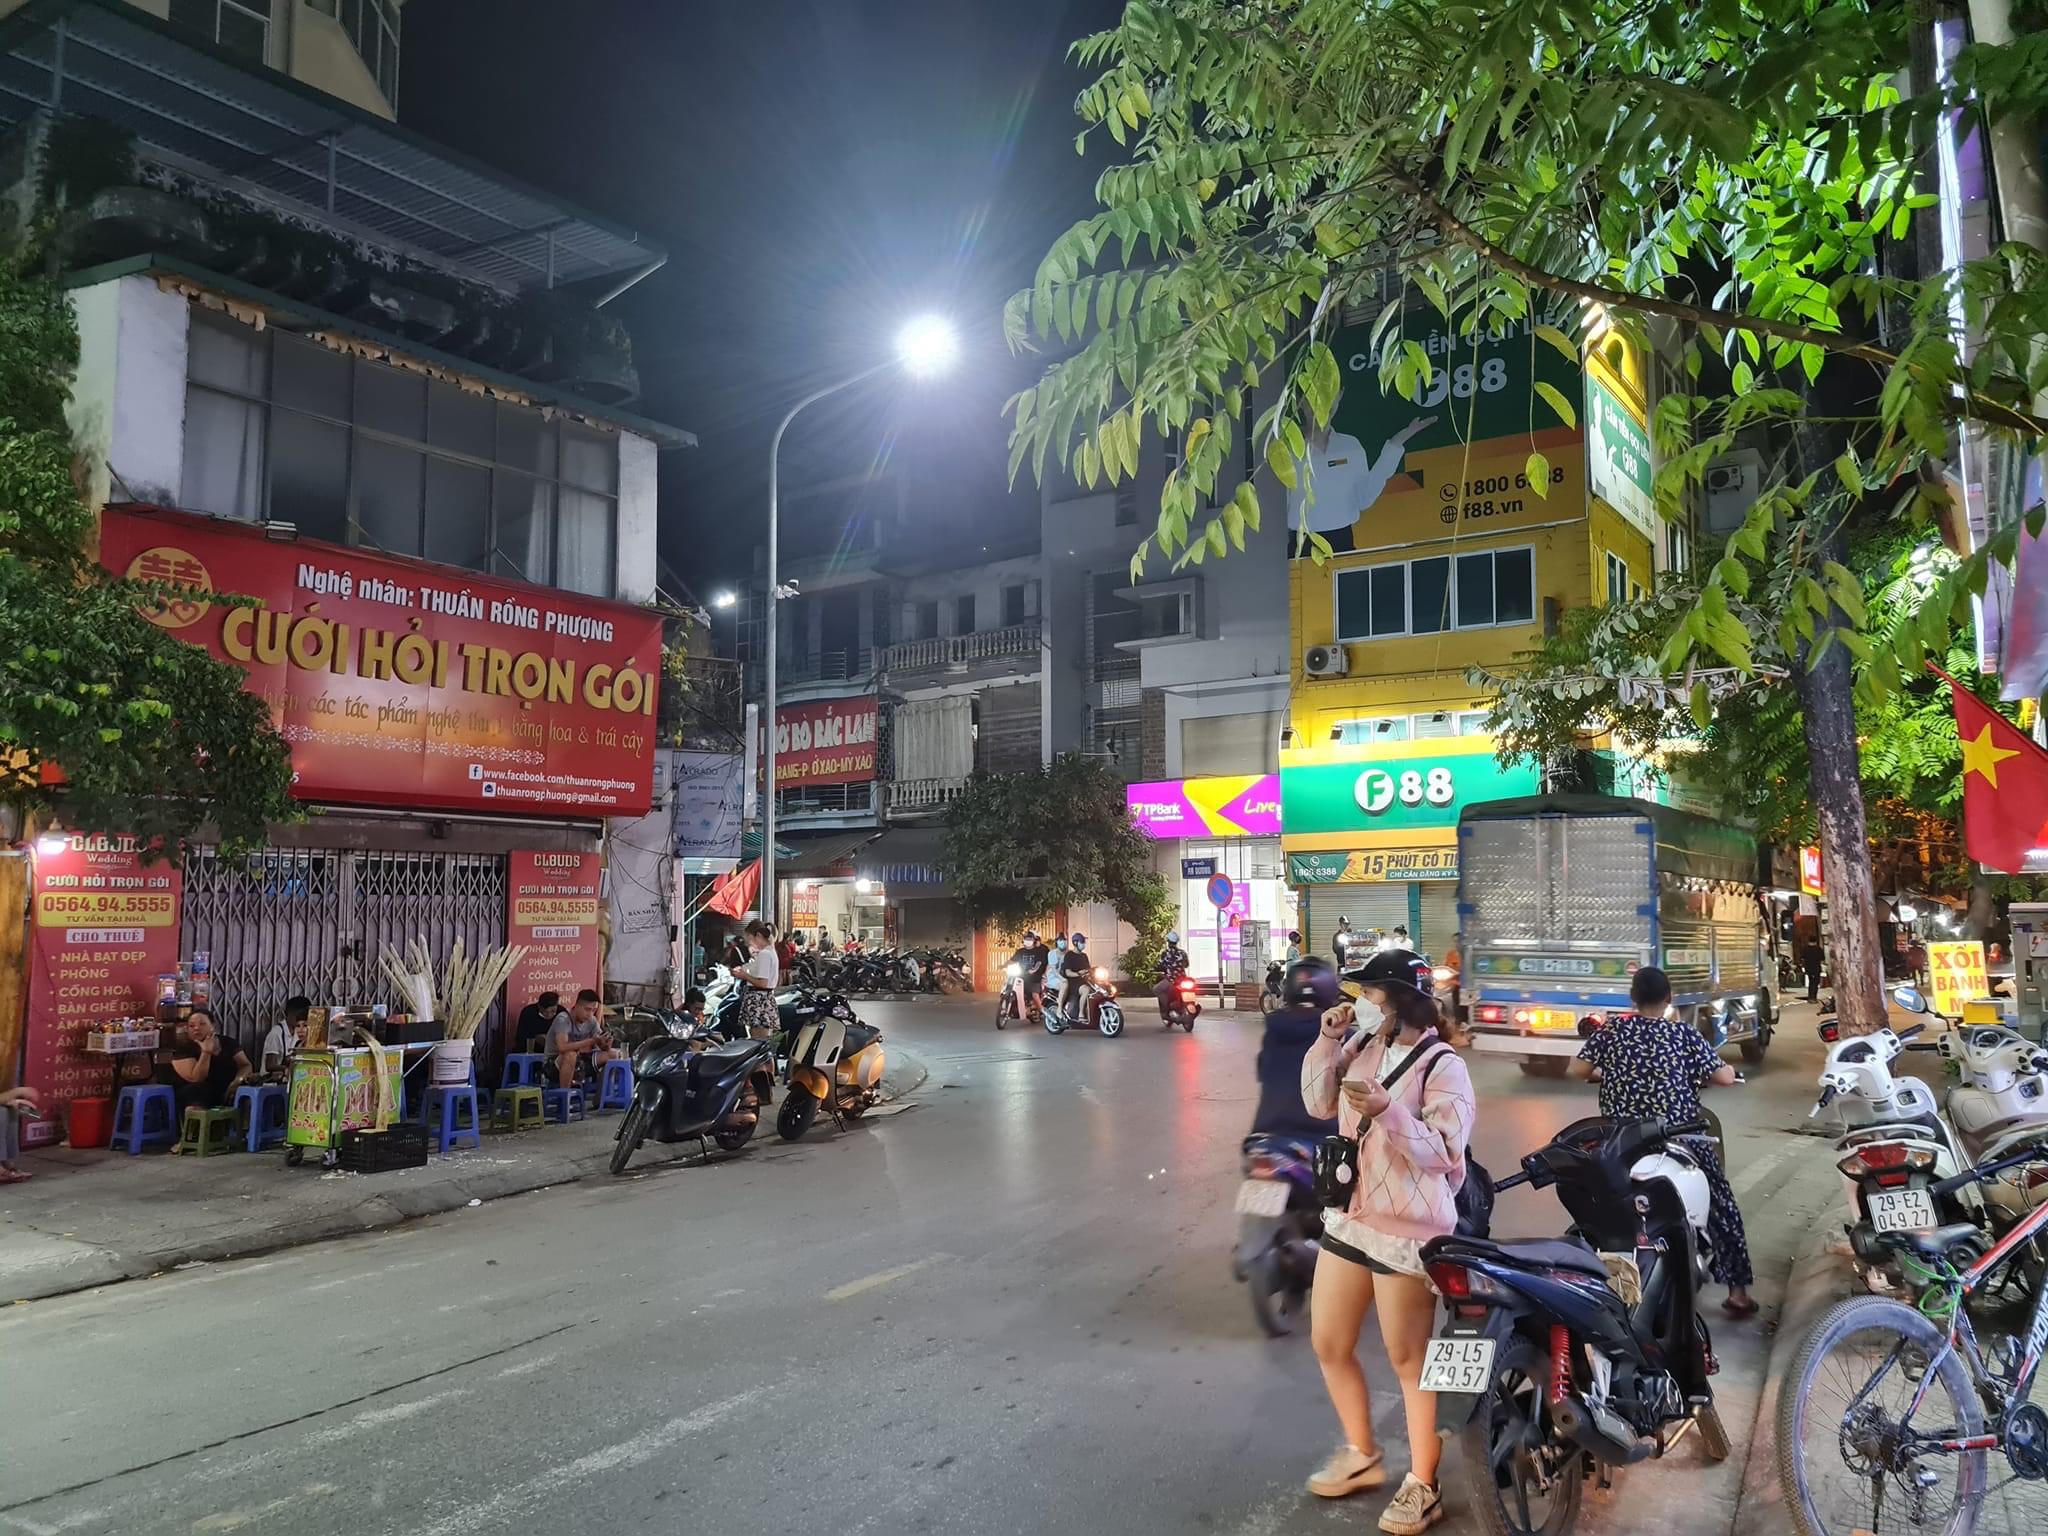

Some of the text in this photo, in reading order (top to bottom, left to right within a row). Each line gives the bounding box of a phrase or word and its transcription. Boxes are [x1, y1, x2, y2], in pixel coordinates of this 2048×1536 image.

[1464, 466, 1564, 497] 1800 68
[1464, 499, 1523, 520] f88.vn
[298, 563, 614, 644] Nghệ nhân: THUẦN RỒNG PHƯỢNG
[222, 602, 655, 716] CƯỚI HỎI TRỌN GÓI
[345, 695, 369, 719] tác
[377, 695, 418, 732] phẩm
[550, 719, 572, 741] hoa
[578, 726, 589, 743] &
[595, 725, 617, 747] trái
[622, 731, 644, 758] cây
[791, 712, 812, 752] BÒ
[814, 705, 843, 749] BẮC
[483, 769, 636, 793] www.facebook.com/thuanrongphuong
[1354, 766, 1455, 811] F88
[496, 785, 617, 804] thuanrongphuong@gmail.com
[1143, 802, 1181, 816] TPBank
[87, 853, 133, 866] Wedding
[534, 854, 581, 867] CLOUDS
[1363, 855, 1384, 875] 15
[1386, 851, 1418, 868] PHÚT
[1422, 850, 1438, 867] CÓ
[46, 873, 170, 889] CƯỚI HỎI TRỌN GÓI
[43, 896, 171, 913] 0564.94.5555
[518, 901, 595, 914] 0564.94.5555
[72, 931, 99, 942] CHO
[535, 928, 553, 937] CHO
[61, 949, 91, 963] NHÀ
[95, 951, 118, 966] BẠT
[104, 985, 132, 996] HOA
[57, 1000, 86, 1015] BÀN
[90, 998, 118, 1013] GHẾ
[1877, 1191, 1923, 1212] 29-E2
[1878, 1208, 1930, 1231] 049.27
[1433, 1342, 1485, 1363] 29-L5
[1423, 1365, 1485, 1388] 429.57
